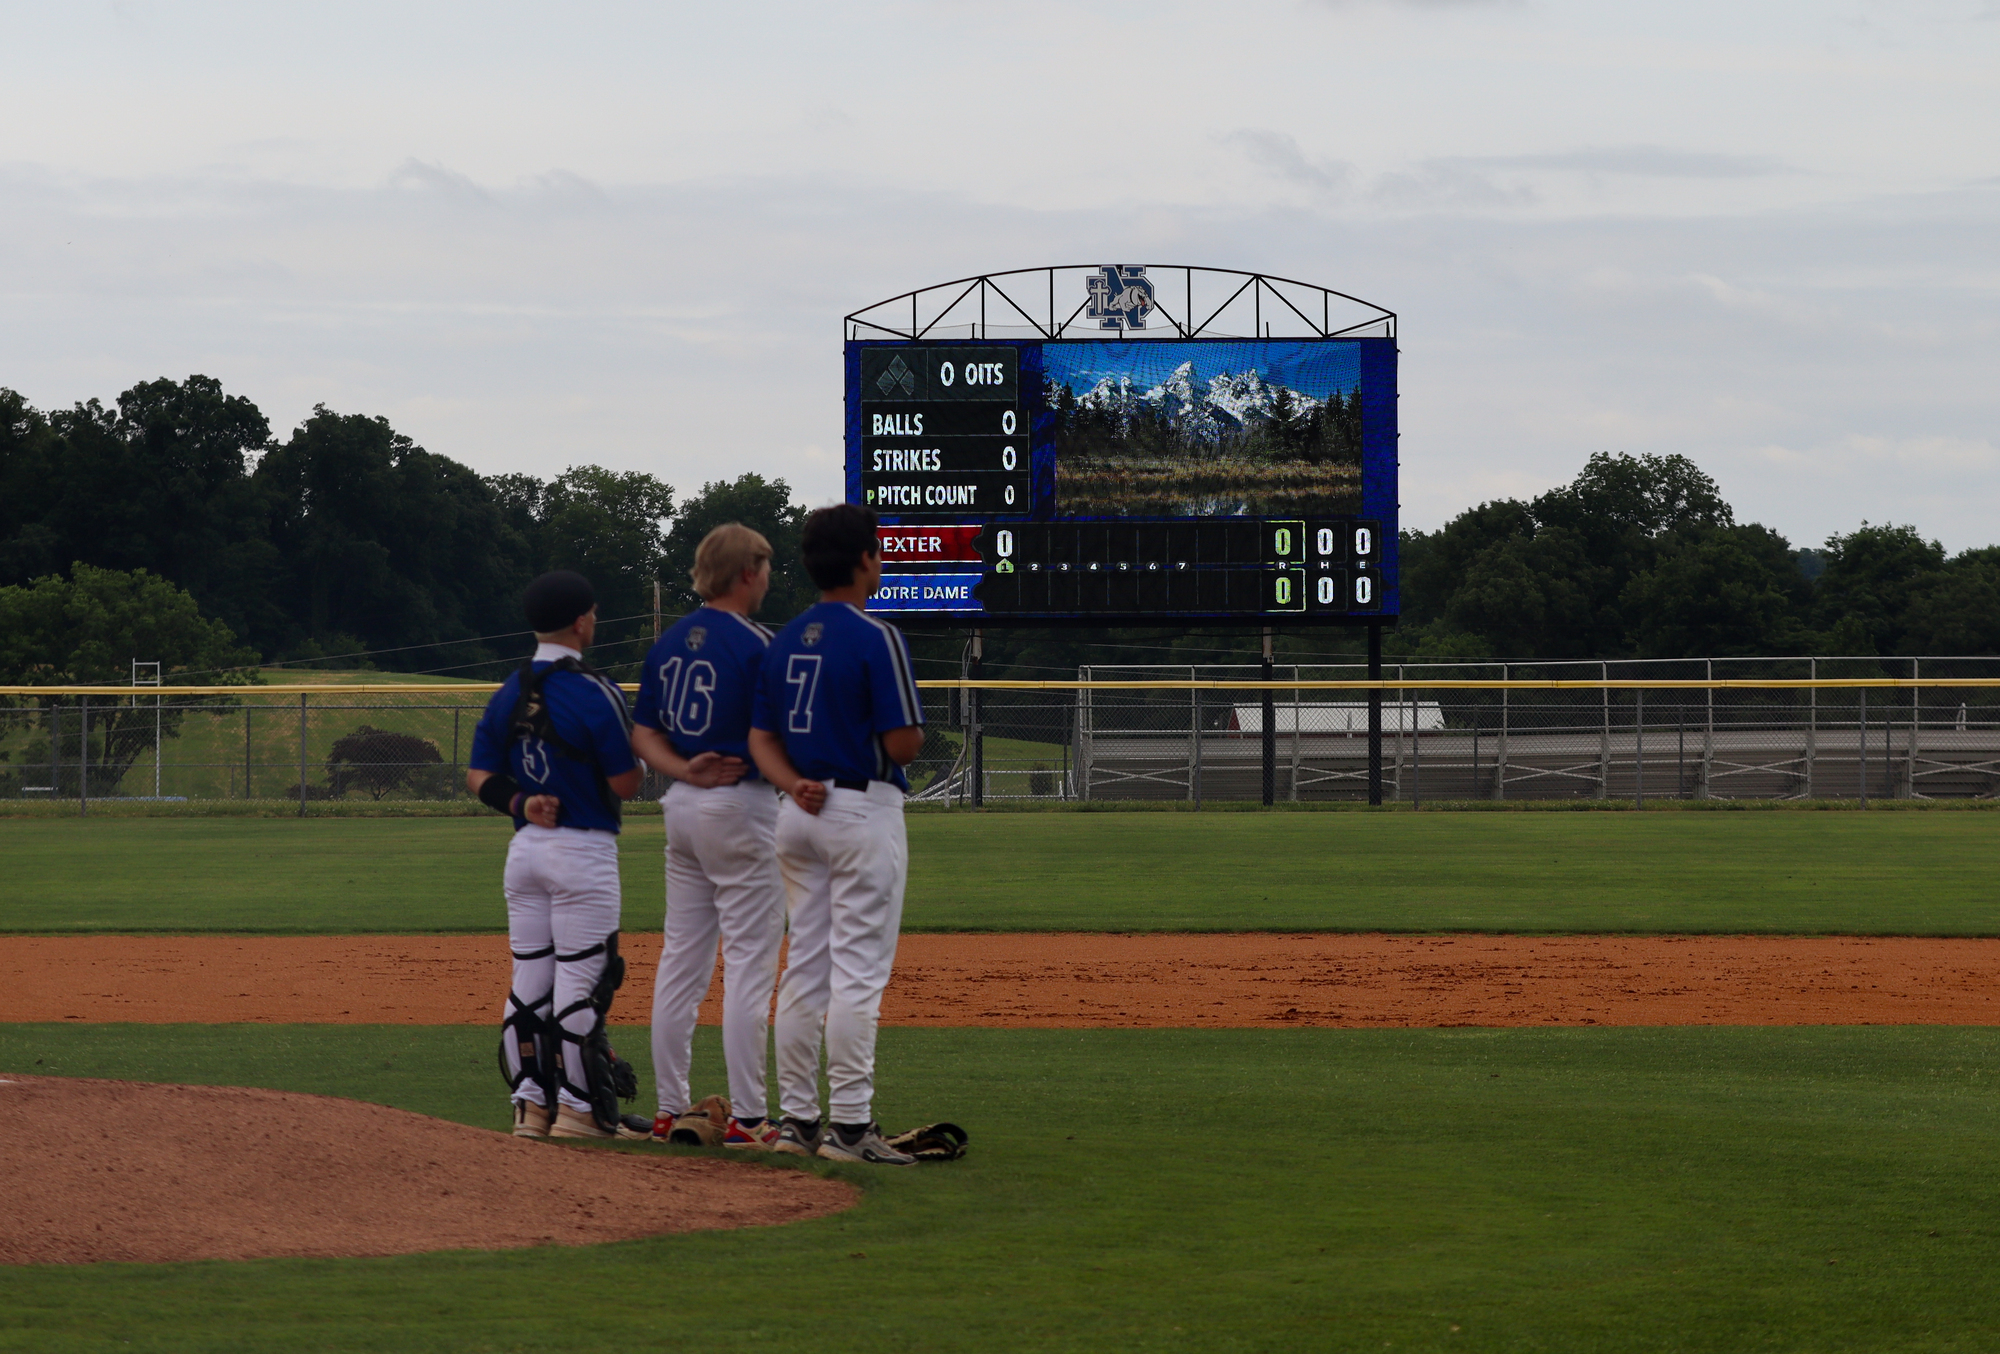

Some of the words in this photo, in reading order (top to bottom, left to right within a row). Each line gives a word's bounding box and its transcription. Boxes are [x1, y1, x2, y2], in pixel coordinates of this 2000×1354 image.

[940, 361, 955, 386] 0
[872, 413, 923, 435] BALLS
[1002, 410, 1016, 435] 0
[872, 449, 941, 471] STRIKES
[1002, 446, 1016, 471] 0
[866, 489, 875, 505] P
[878, 485, 921, 506] PITCH
[925, 485, 977, 506] COUNT
[1004, 484, 1015, 505] 0
[876, 536, 942, 552] EXTER
[997, 529, 1013, 557] 0
[1275, 528, 1291, 555] 0
[1317, 528, 1333, 555] 0
[1355, 528, 1371, 555] 0
[1001, 562, 1010, 572] 1
[1031, 563, 1038, 571] 2
[1061, 563, 1068, 571] 3
[1090, 563, 1098, 571] 4
[1119, 563, 1127, 571] 5
[1149, 563, 1157, 571] 6
[1178, 562, 1186, 570] 7
[1278, 561, 1287, 570] R
[1320, 561, 1330, 570] H
[1359, 561, 1366, 569] E
[923, 586, 969, 599] DAME
[1275, 576, 1291, 604] 0
[1317, 576, 1333, 604] 0
[1355, 576, 1371, 604] 0
[659, 656, 717, 736] 16
[786, 654, 822, 733] 7
